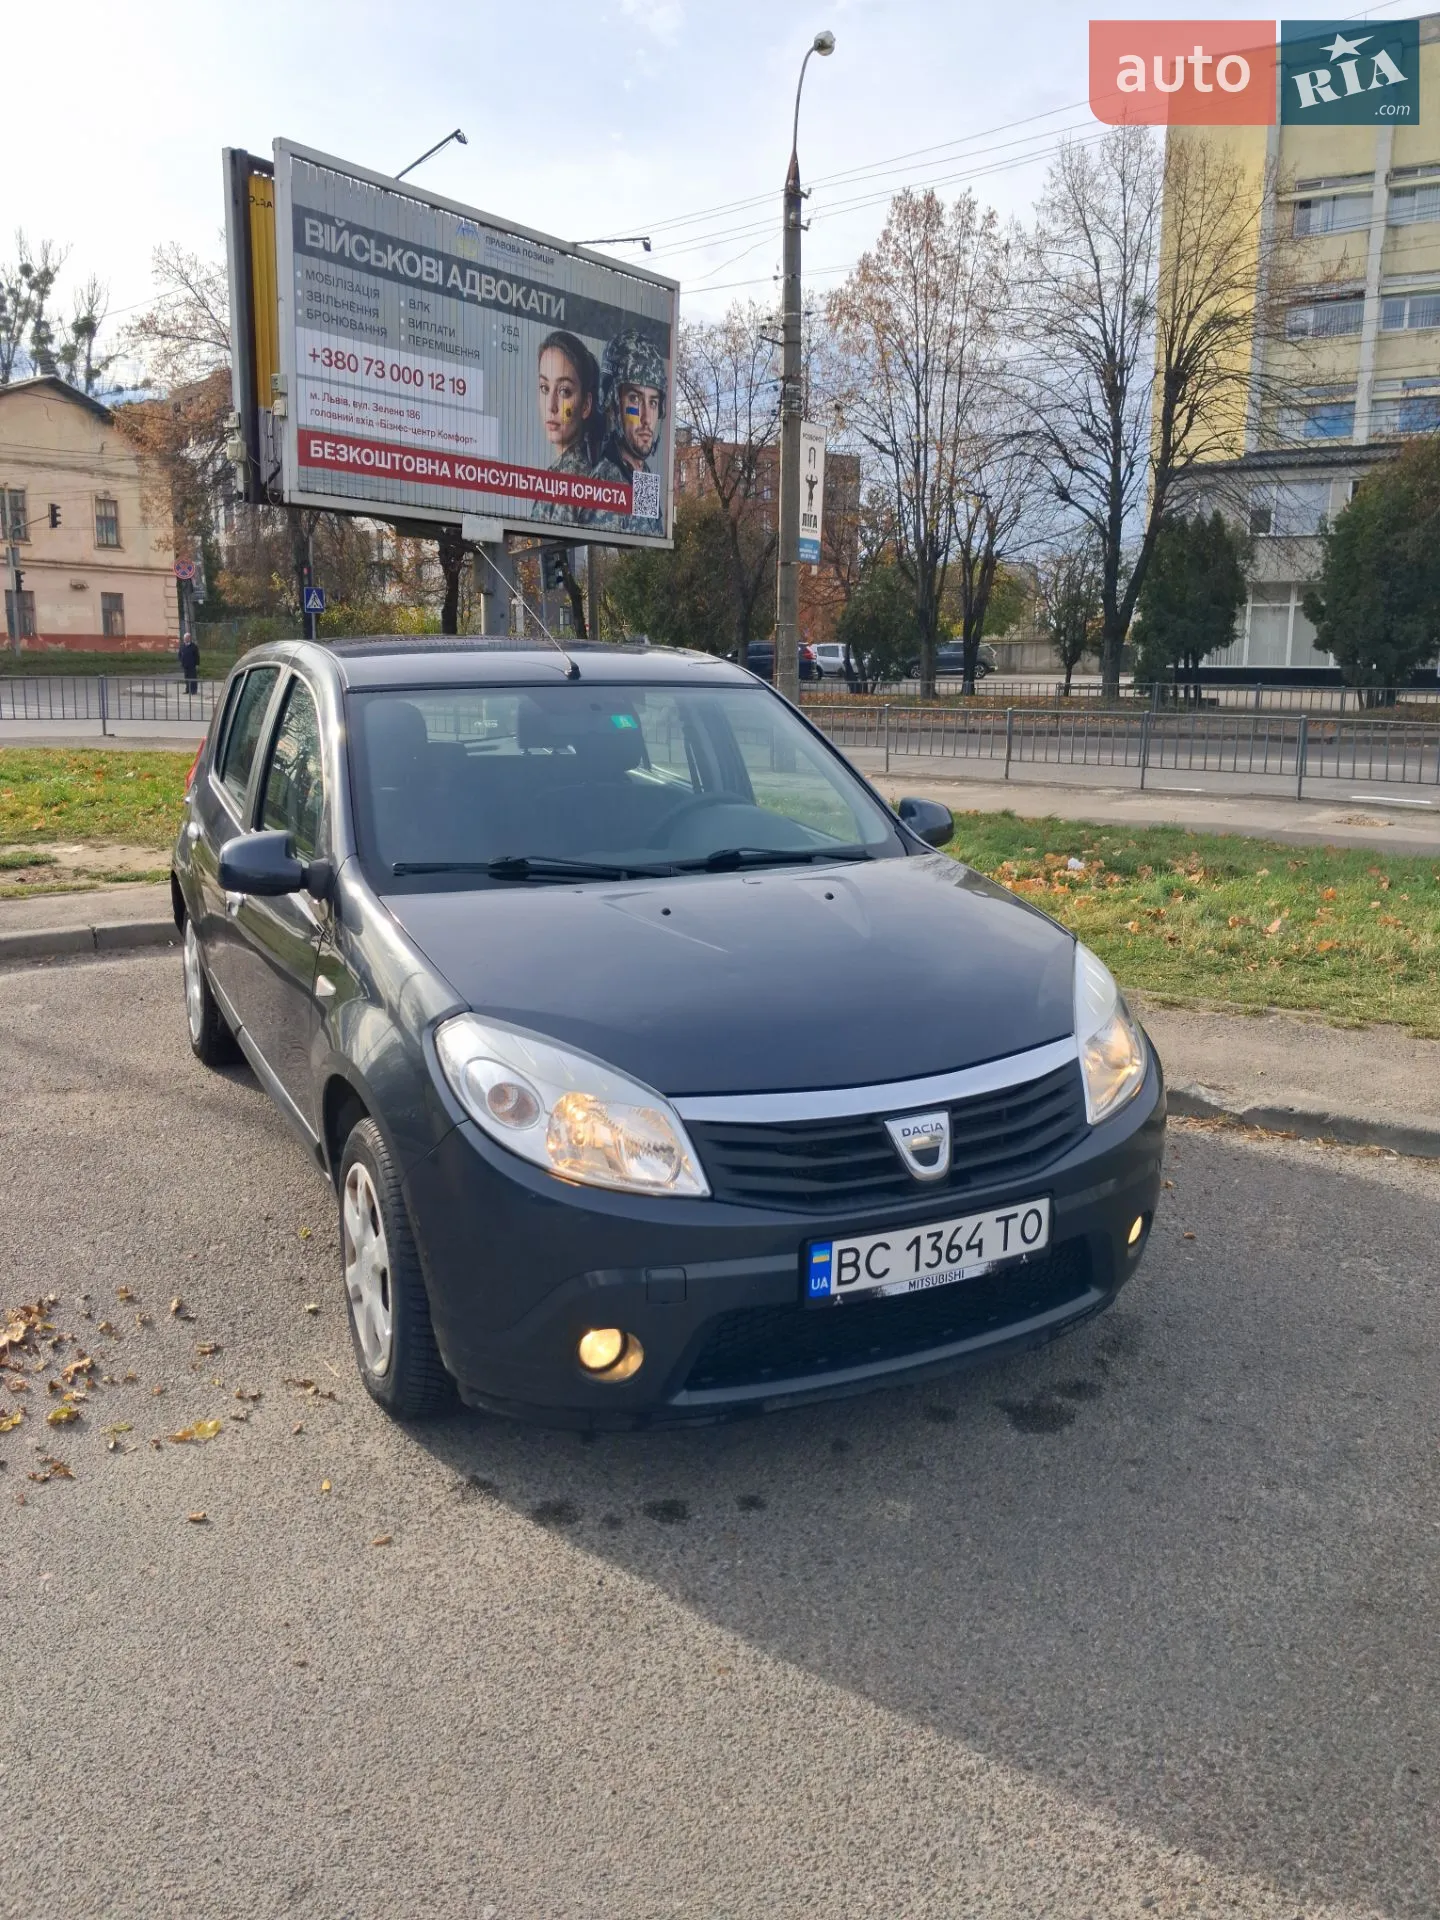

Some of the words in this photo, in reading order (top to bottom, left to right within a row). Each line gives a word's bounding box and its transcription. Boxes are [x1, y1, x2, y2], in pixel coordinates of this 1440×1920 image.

[485, 235, 521, 256] ПРАВОВА
[522, 248, 555, 266] ПОЗИЦІЯ
[304, 217, 443, 286] ВІЙСЬКОВІ
[446, 264, 565, 321] АДВОКАТИ
[305, 268, 380, 300] МОБІЛІЗАЦІЯ
[306, 289, 380, 318] ЗВІЛЬНЕННЯ
[408, 299, 431, 313] ВЛК
[306, 308, 388, 338] БРОНЮВАННЯ
[408, 317, 456, 338] ВИПЛАТИ
[501, 323, 520, 338] УБД
[408, 334, 480, 360] ПЕРЕМІЩЕННЯ
[501, 341, 520, 354] СЗЧ
[308, 347, 359, 373] +380
[363, 357, 386, 379] 73
[389, 363, 424, 387] 000
[428, 372, 446, 392] 12
[450, 377, 467, 397] 19
[309, 392, 320, 401] м.
[322, 392, 350, 407] Львів,
[352, 400, 370, 413] вул.
[372, 402, 405, 417] Зелена
[406, 408, 421, 420] 186
[309, 408, 354, 422] головний
[356, 413, 374, 428] вхід
[310, 439, 451, 478] БЕЗКОШТОВНА
[454, 465, 568, 497] КОНСУЛЬТАЦІЯ
[570, 484, 627, 506] ЮРИСТА
[802, 512, 818, 529] ЛІГА
[901, 1122, 944, 1137] DACIA
[836, 1241, 891, 1287] BC
[905, 1220, 984, 1273] 1364
[995, 1208, 1043, 1252] TO
[811, 1277, 829, 1291] UA
[907, 1270, 966, 1291] MITSUBISHI
